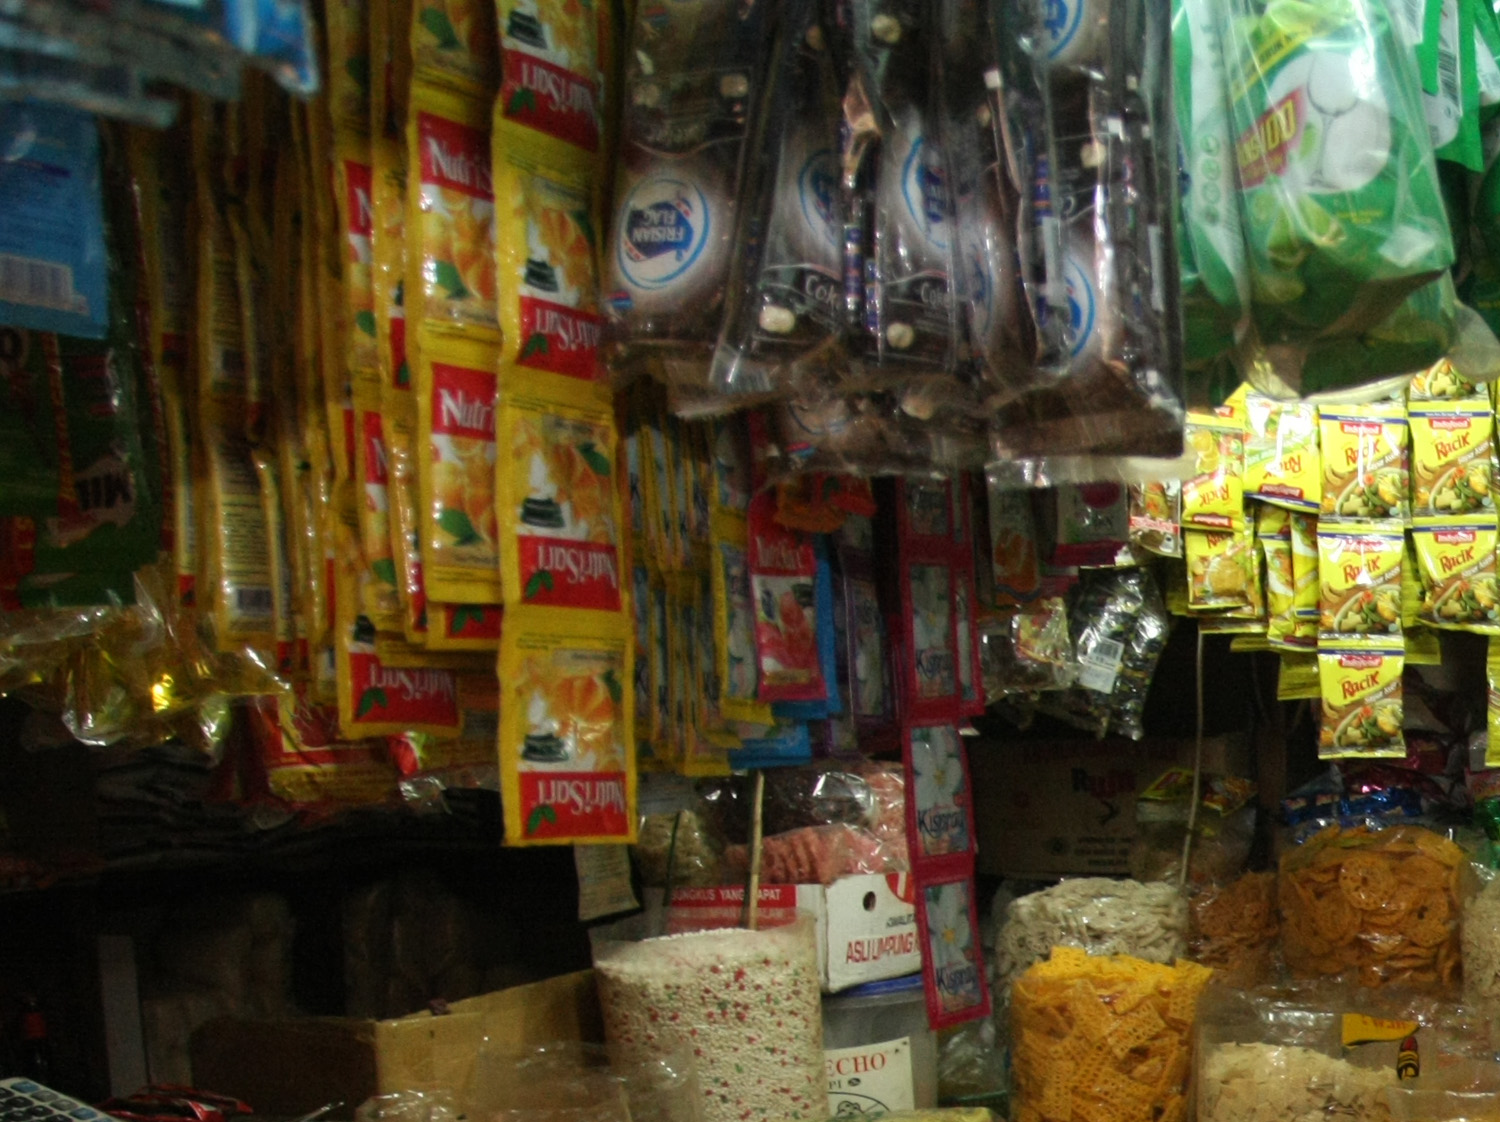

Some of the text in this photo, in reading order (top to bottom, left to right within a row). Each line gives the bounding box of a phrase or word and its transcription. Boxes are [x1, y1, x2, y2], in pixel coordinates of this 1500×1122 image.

[642, 207, 678, 227] FLAG
[630, 225, 687, 245] FRISIAN
[1342, 670, 1380, 700] Racik
